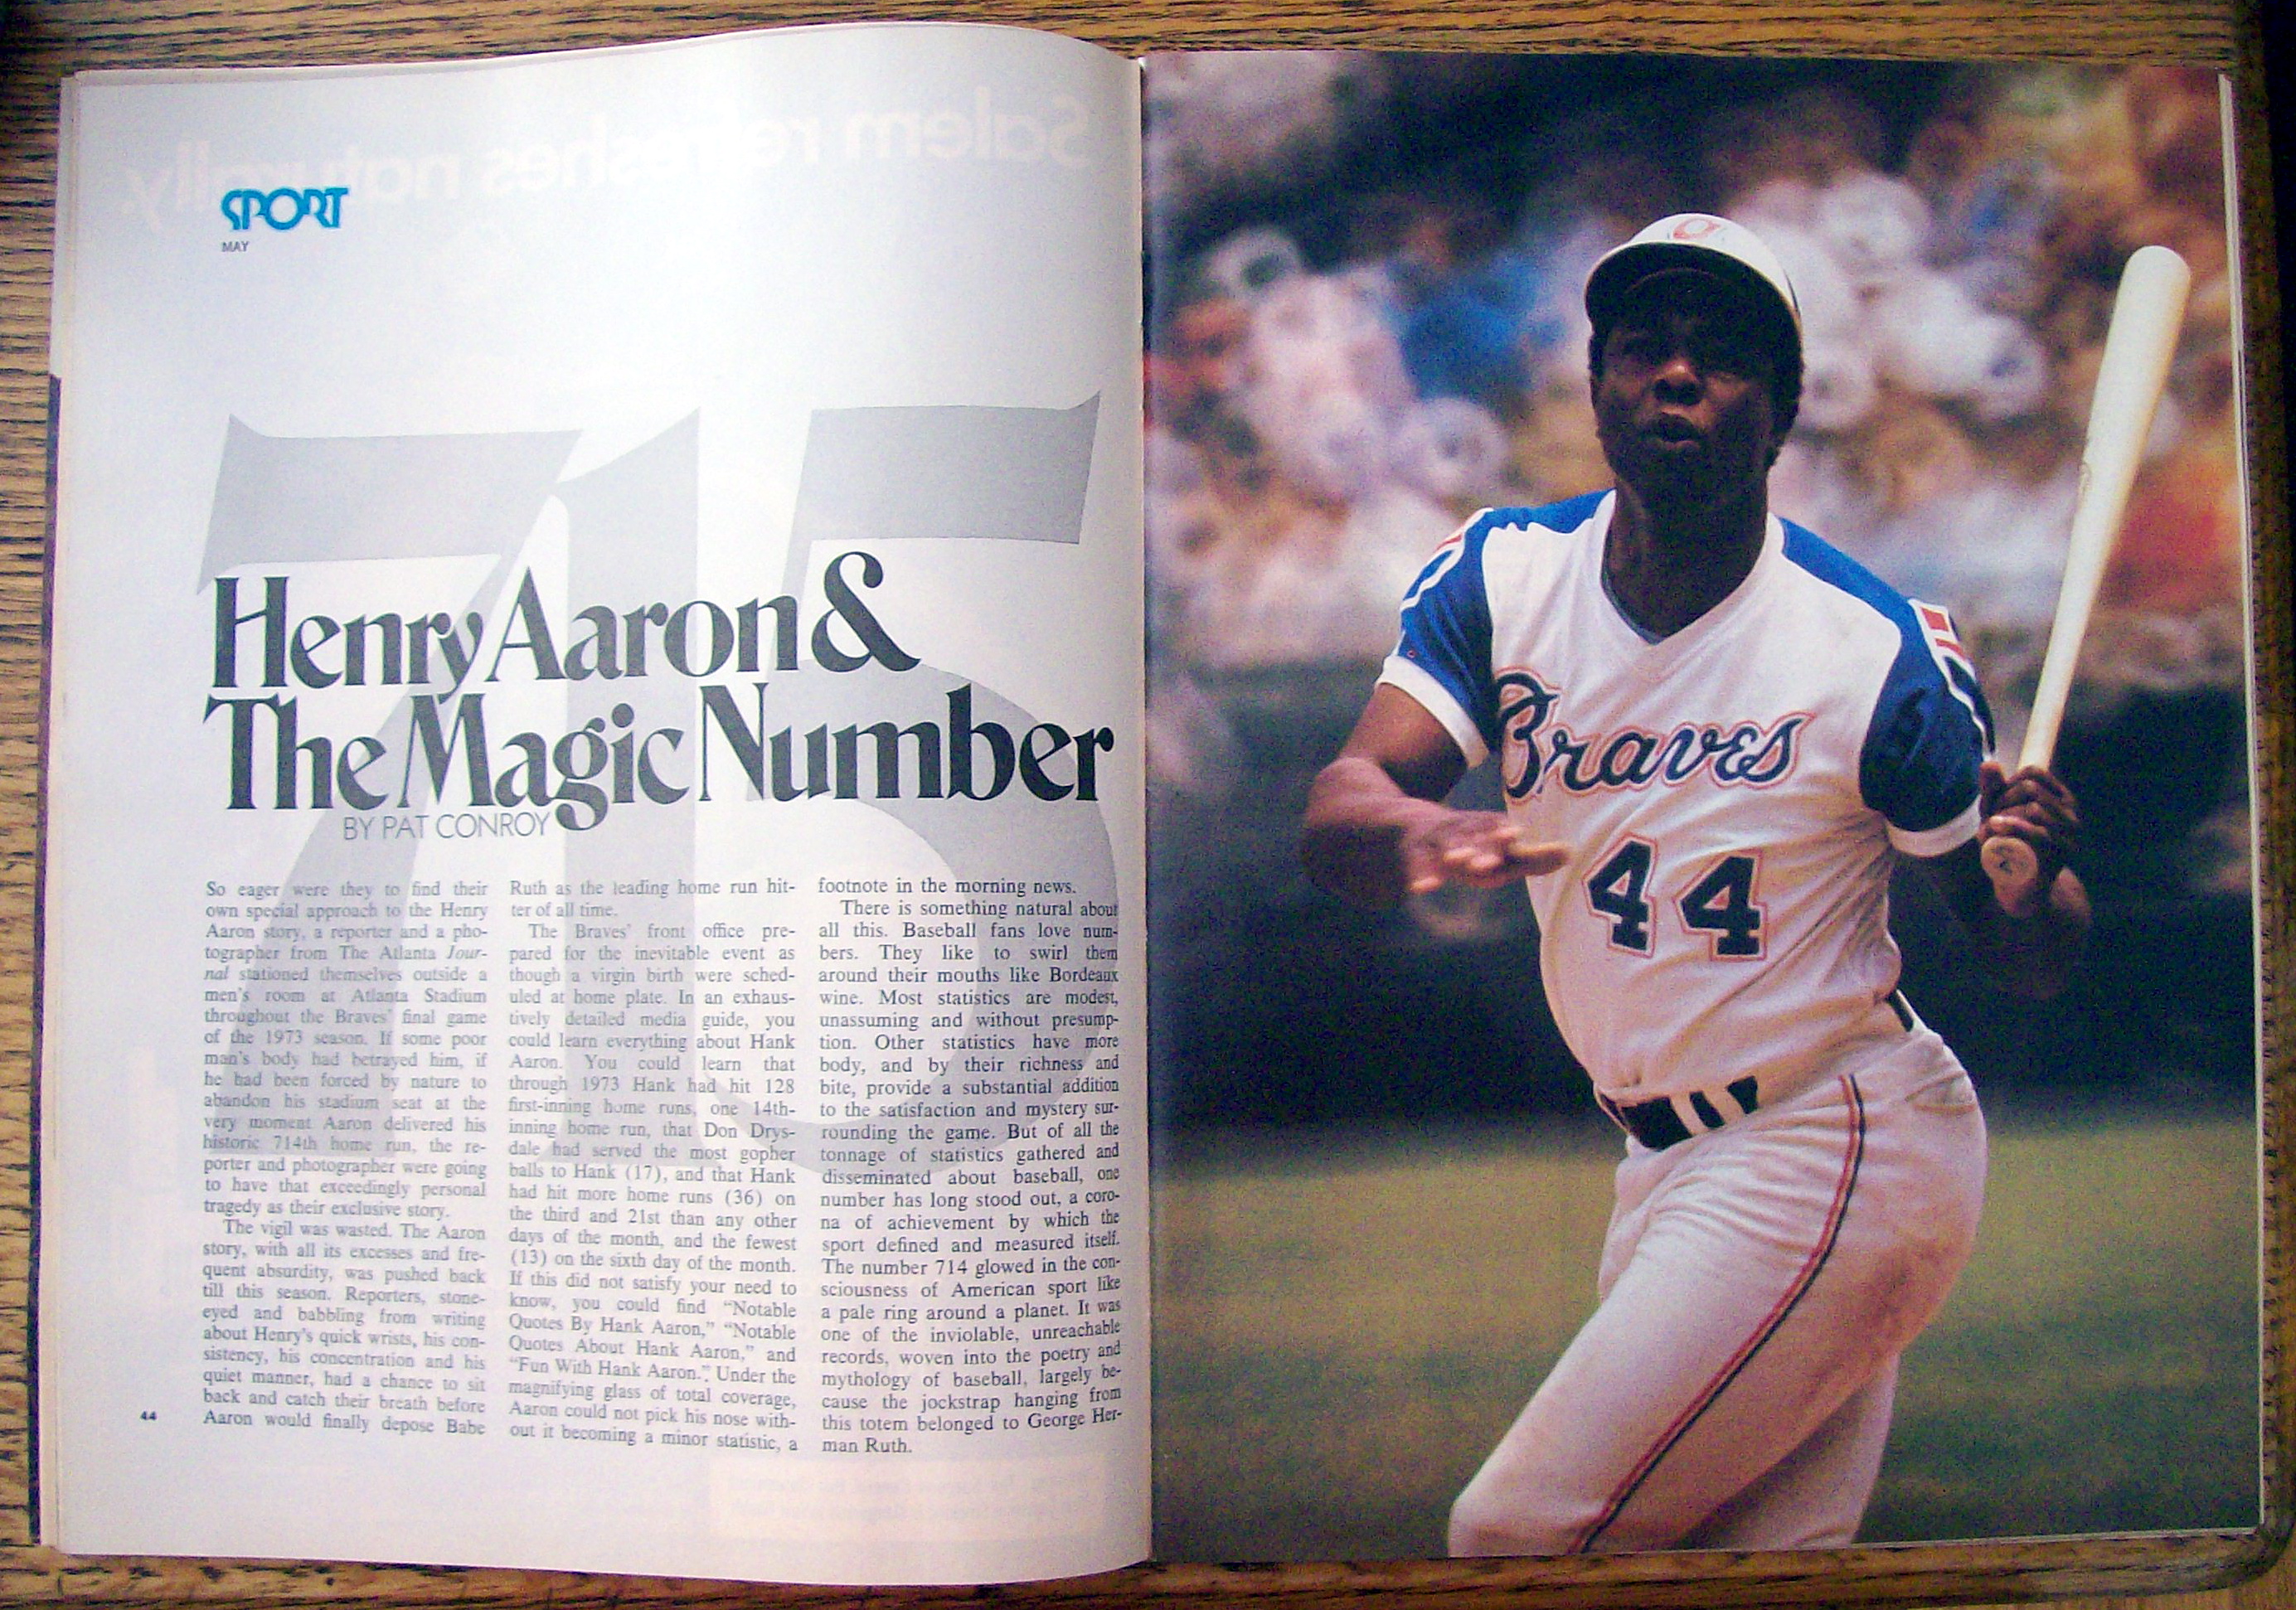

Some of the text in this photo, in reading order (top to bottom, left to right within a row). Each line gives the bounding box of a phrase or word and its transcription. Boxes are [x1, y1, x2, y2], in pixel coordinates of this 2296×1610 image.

[221, 187, 348, 230] SPORT
[222, 241, 250, 252] MAY
[212, 551, 922, 705] Henry Aaron &
[1492, 665, 1816, 805] Braves
[203, 682, 1114, 832] The Magic Number
[343, 812, 551, 841] BY PAT CONROY
[206, 880, 488, 901] So eager were they to find their
[510, 879, 547, 896] Ruth
[556, 885, 571, 895] as
[580, 880, 604, 895] the
[613, 879, 669, 900] leading
[677, 878, 721, 895] home
[730, 881, 758, 894] run
[818, 876, 1076, 898] footnote in the morning news.
[1582, 832, 1767, 961] 44
[206, 902, 488, 923] own special approach to the Henry
[839, 899, 1119, 919] There is something natural about
[527, 923, 558, 938] The
[575, 924, 631, 939] Braves'
[648, 922, 686, 938] front
[701, 922, 745, 938] office
[818, 921, 1118, 938] all this. Baseball fans love num-
[820, 943, 1118, 965] bers. They like to swirl them
[818, 966, 1119, 983] around their mouths like Bordeaux
[507, 1032, 796, 1053] could learn everything about Hank
[204, 1157, 487, 1180] porter and photographer were going
[823, 1166, 1119, 1186] disseminated about baseball, one
[508, 1182, 537, 1200] had
[546, 1184, 568, 1200] hit
[577, 1189, 617, 1201] more
[627, 1185, 669, 1203] home
[679, 1192, 713, 1204] runs
[774, 1194, 796, 1206] on
[821, 1190, 1120, 1211] number has long stood out, a coro-
[203, 1196, 262, 1218] tragedy
[267, 1202, 284, 1215] as
[289, 1199, 327, 1215] their
[330, 1200, 401, 1217] exclusive
[821, 1208, 1119, 1234] na of achievement by which the
[821, 1254, 1121, 1279] The number 714 glowed in the con-
[572, 1297, 600, 1314] you
[616, 1295, 659, 1312] could
[677, 1297, 706, 1315] find
[821, 1299, 1121, 1324] a pale ring around a planet. It was
[201, 1302, 485, 1331] eyed and babbling from writing
[139, 1410, 157, 1421] 44
[202, 1409, 486, 1437] Aaron would finally depose Babe
[509, 1424, 536, 1438] out
[543, 1423, 554, 1439] it
[561, 1423, 636, 1447] becoming
[644, 1433, 653, 1443] a
[661, 1429, 709, 1447] minor
[789, 1438, 799, 1452] a
[822, 1437, 912, 1453] man Ruth.
